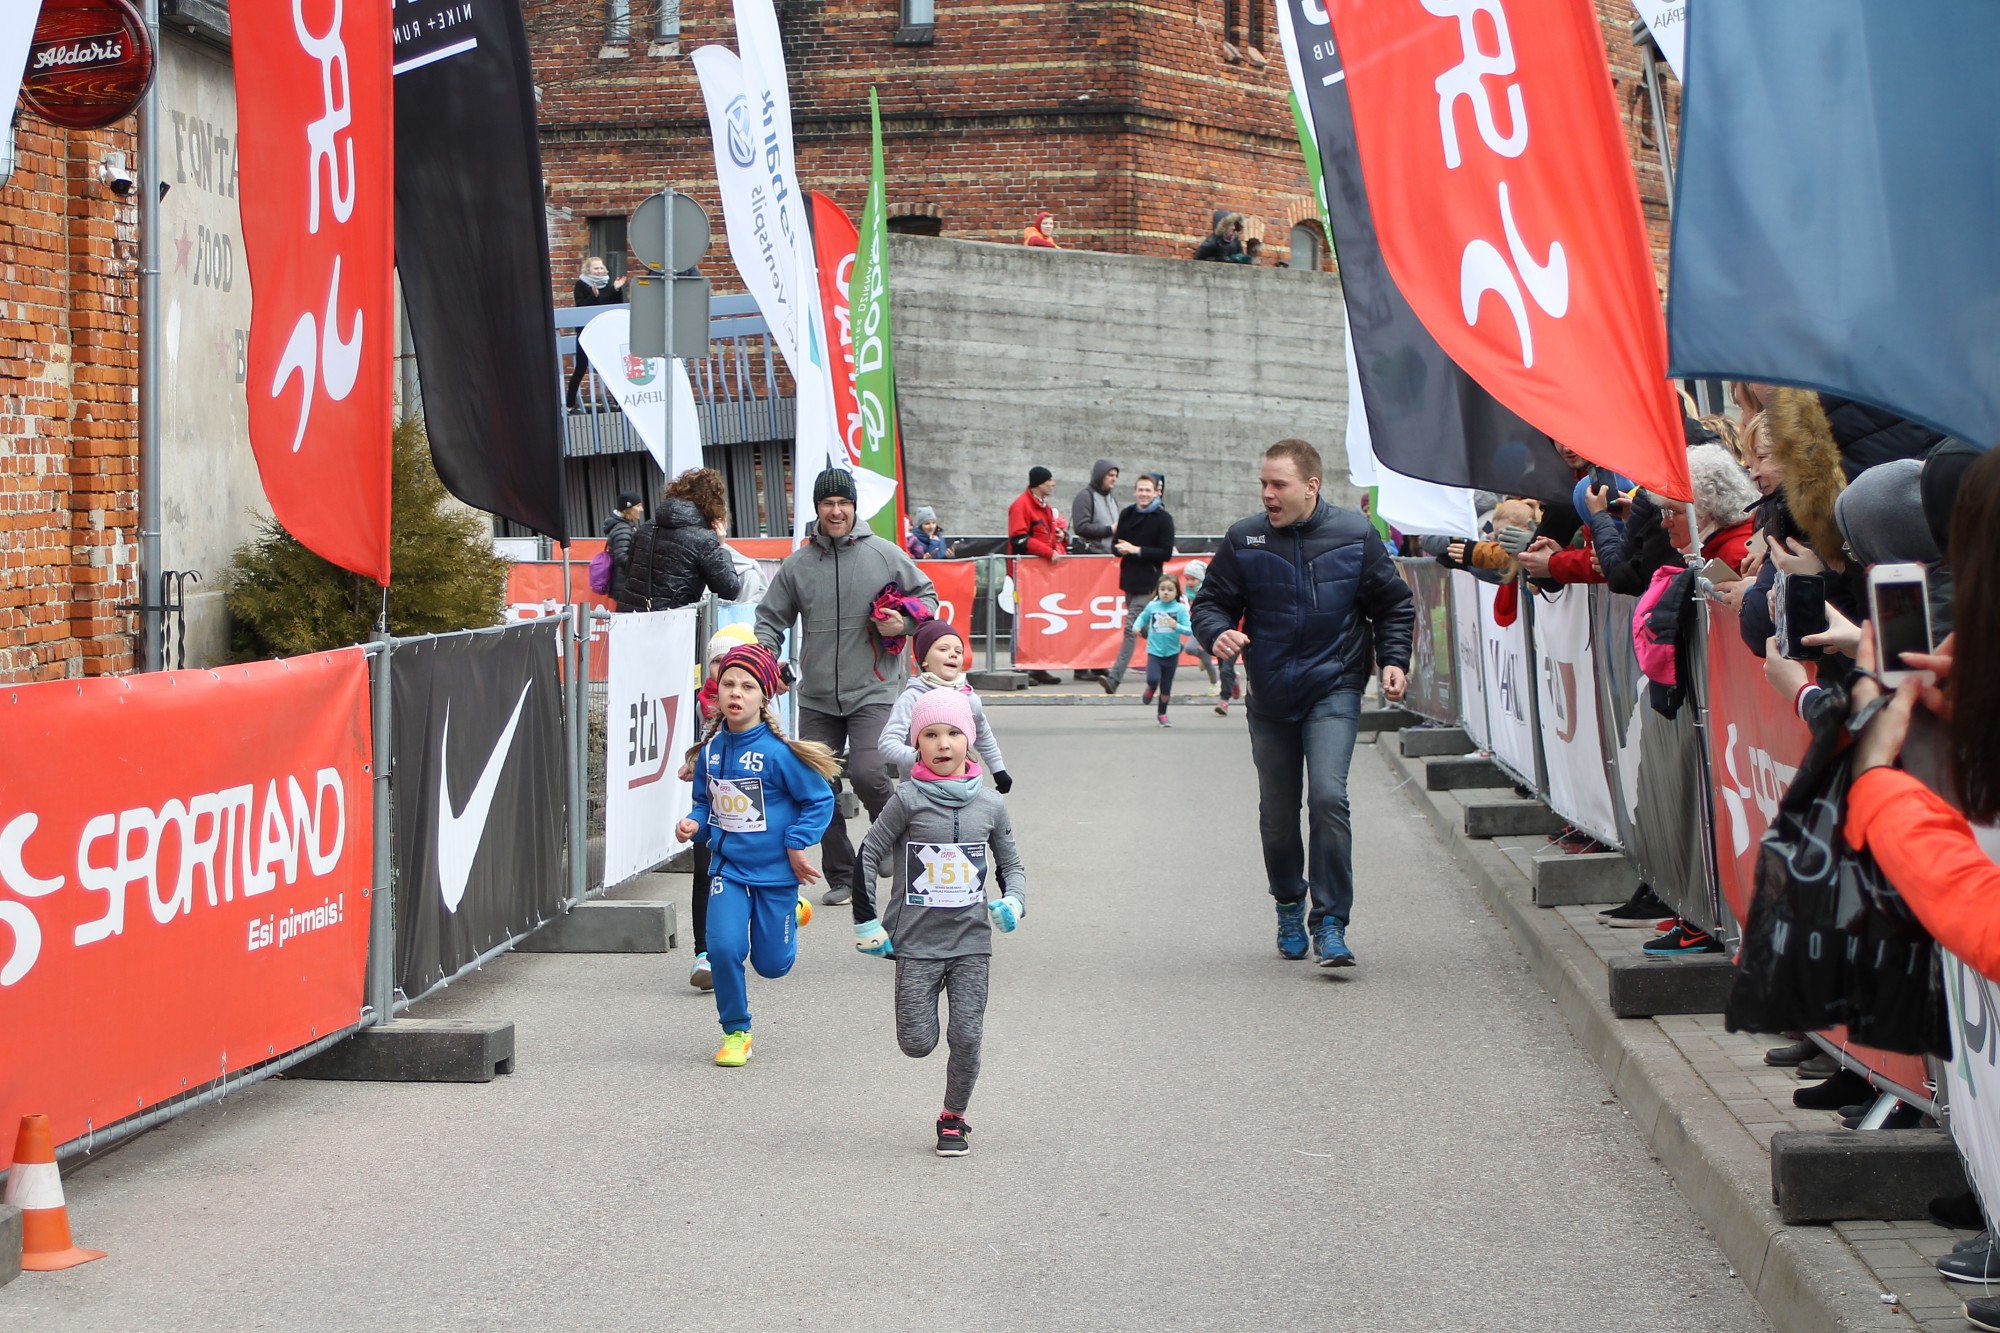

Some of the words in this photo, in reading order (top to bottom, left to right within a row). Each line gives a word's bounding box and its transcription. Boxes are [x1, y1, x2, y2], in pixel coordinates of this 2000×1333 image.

[33, 40, 122, 69] Aldaris
[193, 224, 233, 293] FOOD
[738, 751, 765, 772] 45
[712, 793, 750, 814] 100
[74, 767, 346, 947] SPORTLAND
[925, 862, 970, 885] 151
[247, 914, 275, 951] Esi
[279, 892, 344, 948] pirmais!
